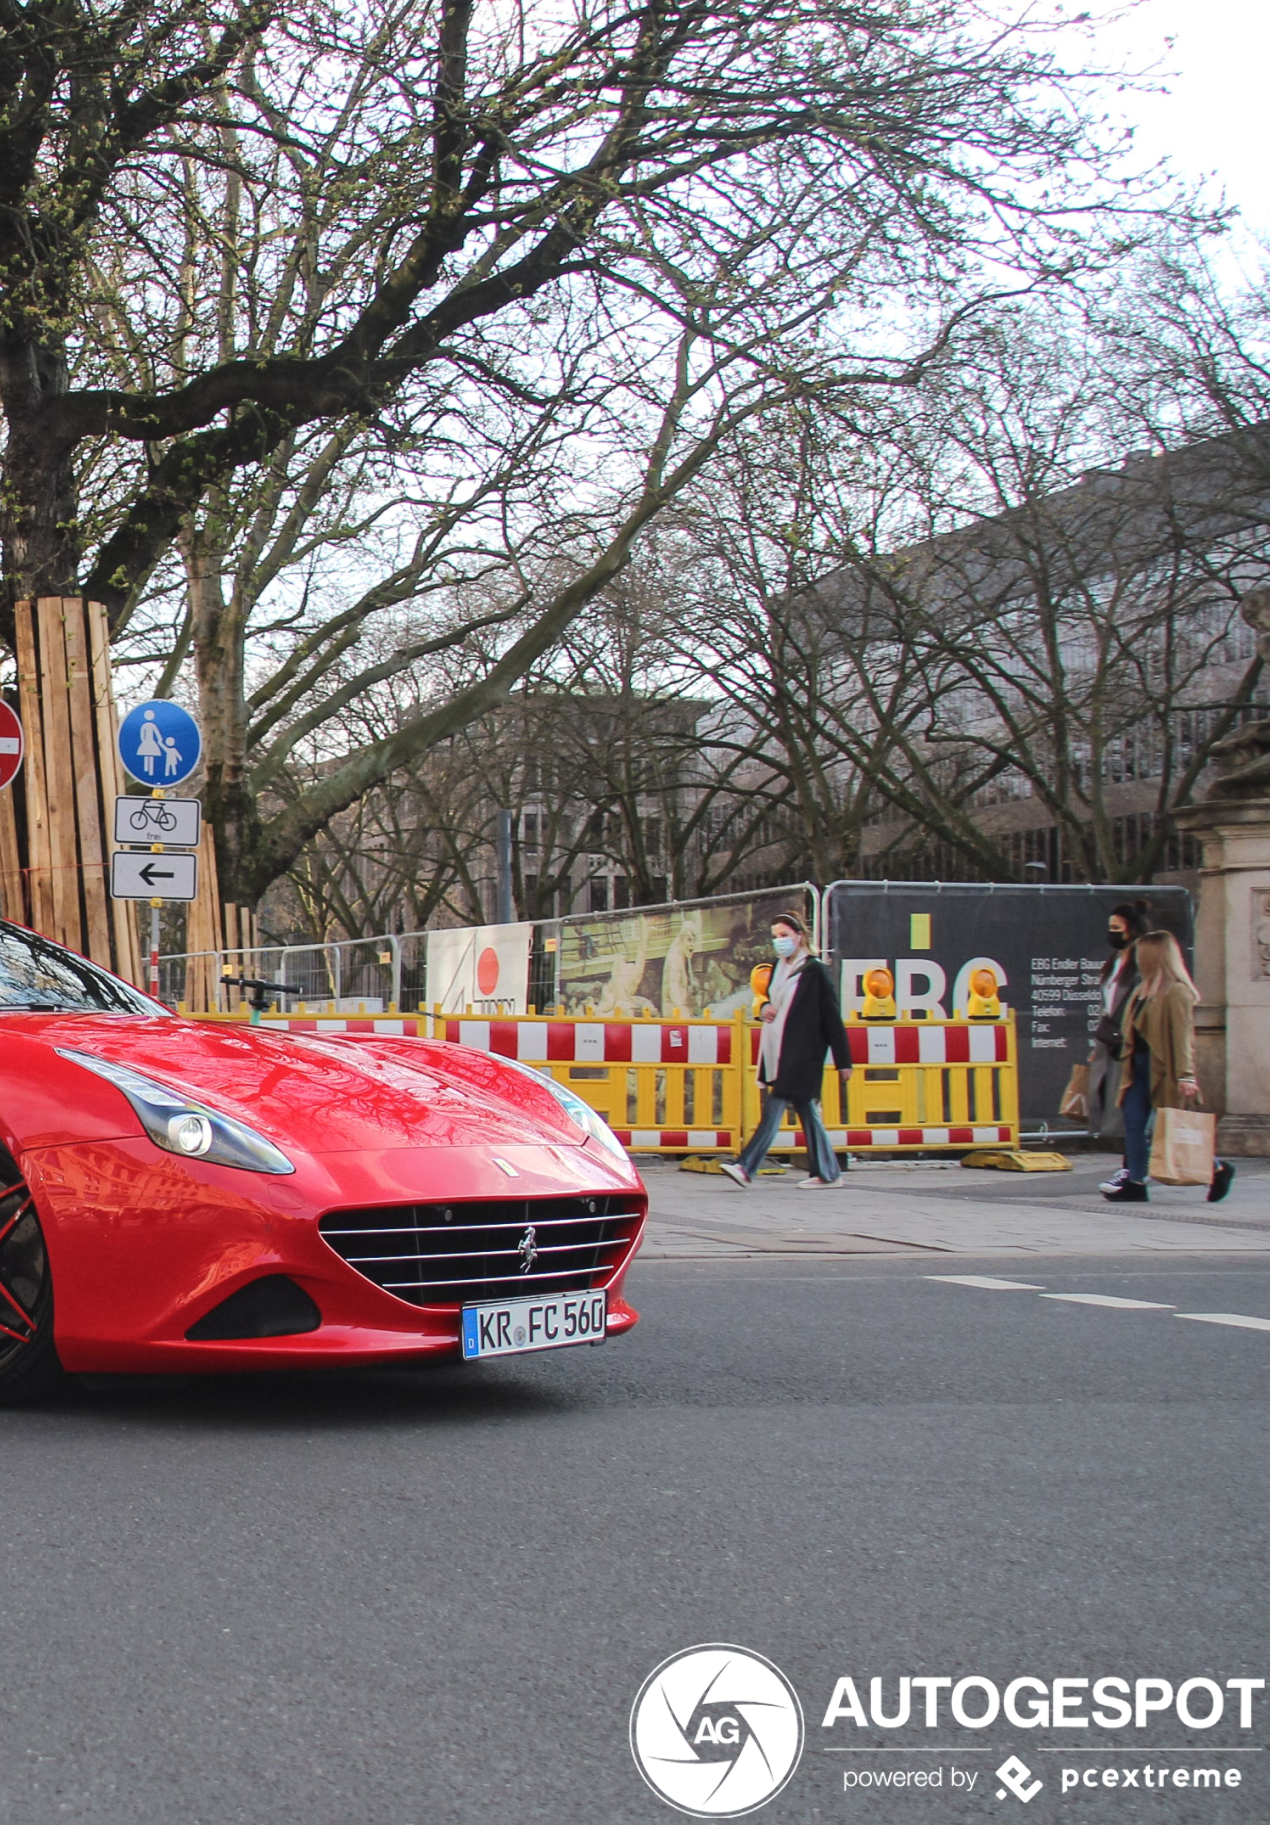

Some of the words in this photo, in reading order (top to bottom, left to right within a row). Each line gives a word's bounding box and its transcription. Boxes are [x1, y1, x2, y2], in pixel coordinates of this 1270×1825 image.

[147, 832, 161, 840] frei
[1031, 958, 1050, 970] EBG
[1052, 958, 1079, 970] Endler
[1031, 974, 1079, 988] Nürnberger
[1081, 974, 1101, 985] Stra
[1031, 989, 1061, 1001] 40599
[1062, 989, 1102, 1001] Düsseldo
[1032, 1005, 1066, 1017] Telefon:
[1087, 1004, 1100, 1016] 02
[1032, 1037, 1067, 1048] Internet:
[480, 1309, 512, 1349] KR
[529, 1303, 558, 1342] FC
[564, 1297, 603, 1337] 560
[468, 1338, 475, 1349] D
